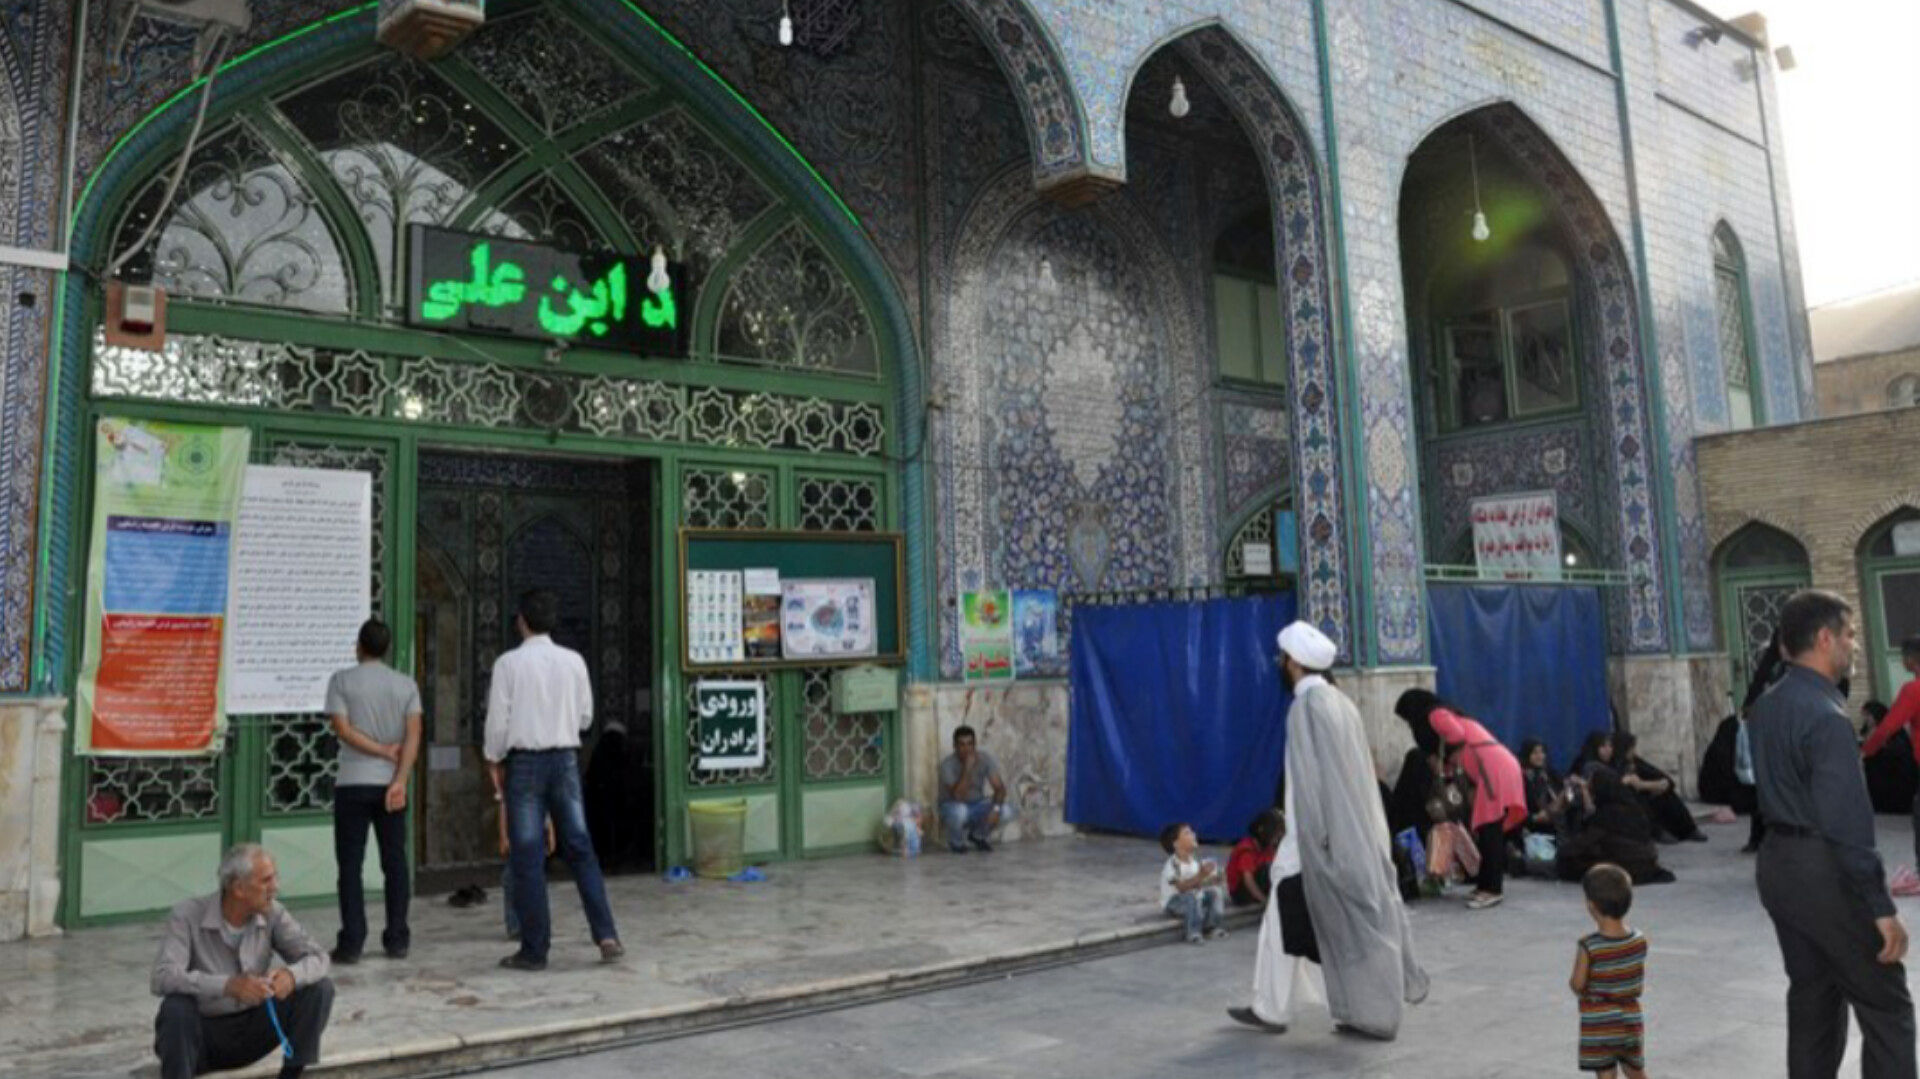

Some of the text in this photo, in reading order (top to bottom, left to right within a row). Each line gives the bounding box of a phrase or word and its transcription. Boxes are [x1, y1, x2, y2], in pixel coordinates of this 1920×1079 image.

[422, 242, 526, 320] علی
[538, 261, 627, 336] ابن
[700, 691, 756, 718] ورودی
[701, 727, 758, 754] برادران
